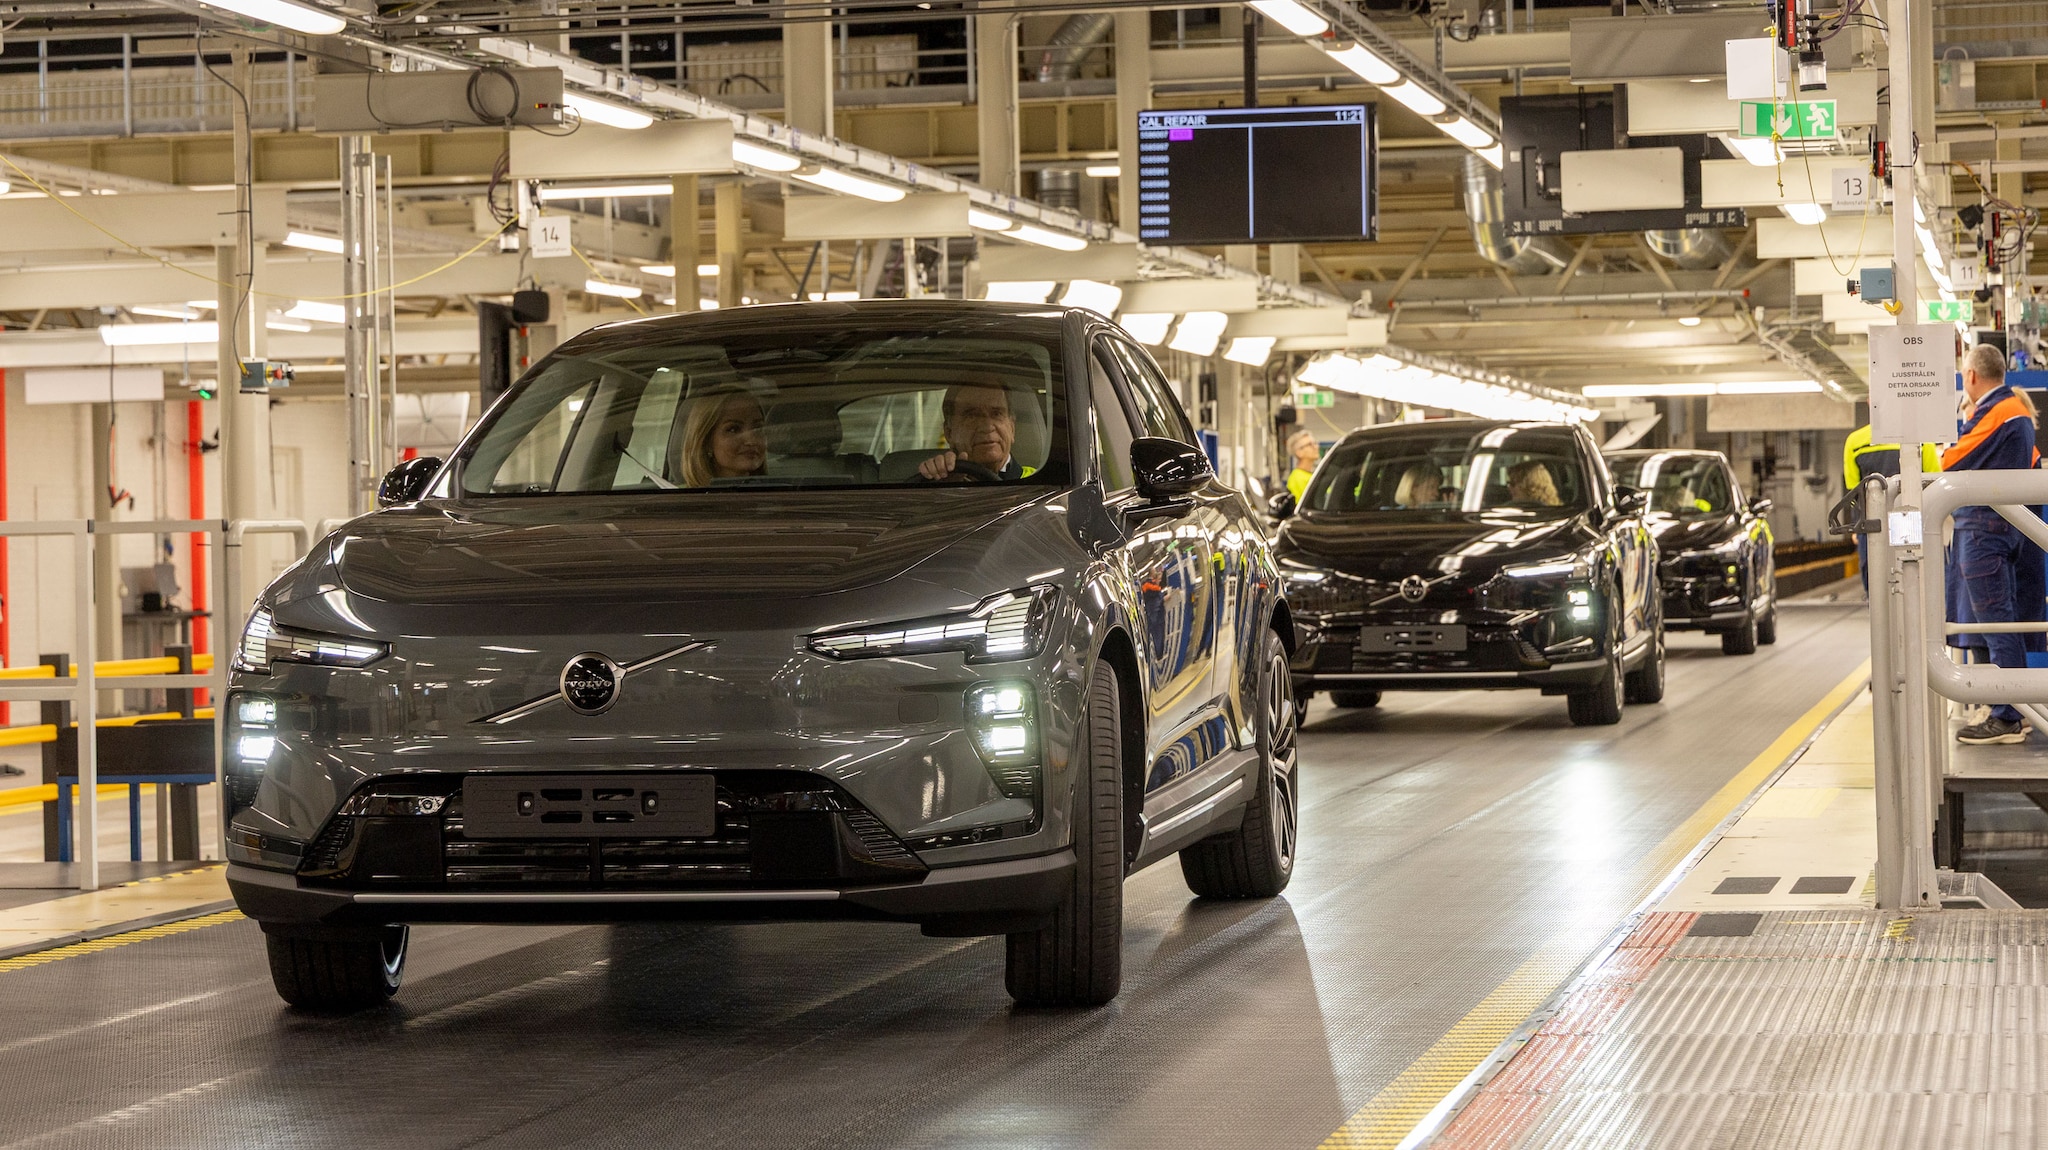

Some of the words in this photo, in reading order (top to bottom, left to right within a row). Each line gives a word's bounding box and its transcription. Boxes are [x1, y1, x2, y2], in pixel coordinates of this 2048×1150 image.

[1139, 116, 1162, 127] CAL
[1163, 115, 1207, 126] REPAIR
[1335, 110, 1362, 121] 11:21
[1843, 177, 1862, 196] 13
[541, 226, 560, 243] 14
[1961, 265, 1973, 280] 11
[1903, 337, 1923, 345] OBS
[1892, 370, 1936, 378] LJUSSTRÅLEN
[570, 680, 613, 688] VOLVO
